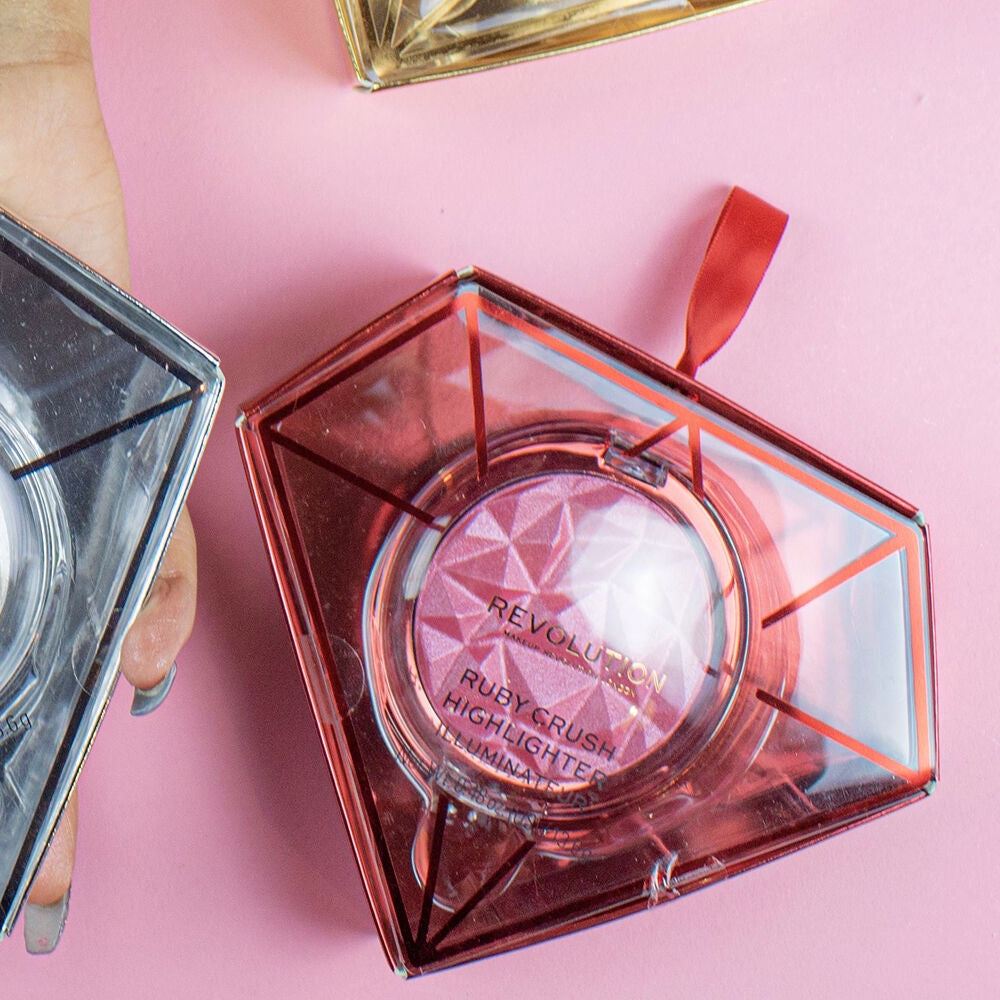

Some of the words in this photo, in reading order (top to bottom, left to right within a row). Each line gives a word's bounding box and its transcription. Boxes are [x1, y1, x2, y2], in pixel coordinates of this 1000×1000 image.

[487, 595, 669, 694] REVOLUTION
[442, 691, 609, 792] HIGHLIGHTER
[460, 668, 529, 715] RUBY
[531, 706, 617, 763] CRUSH
